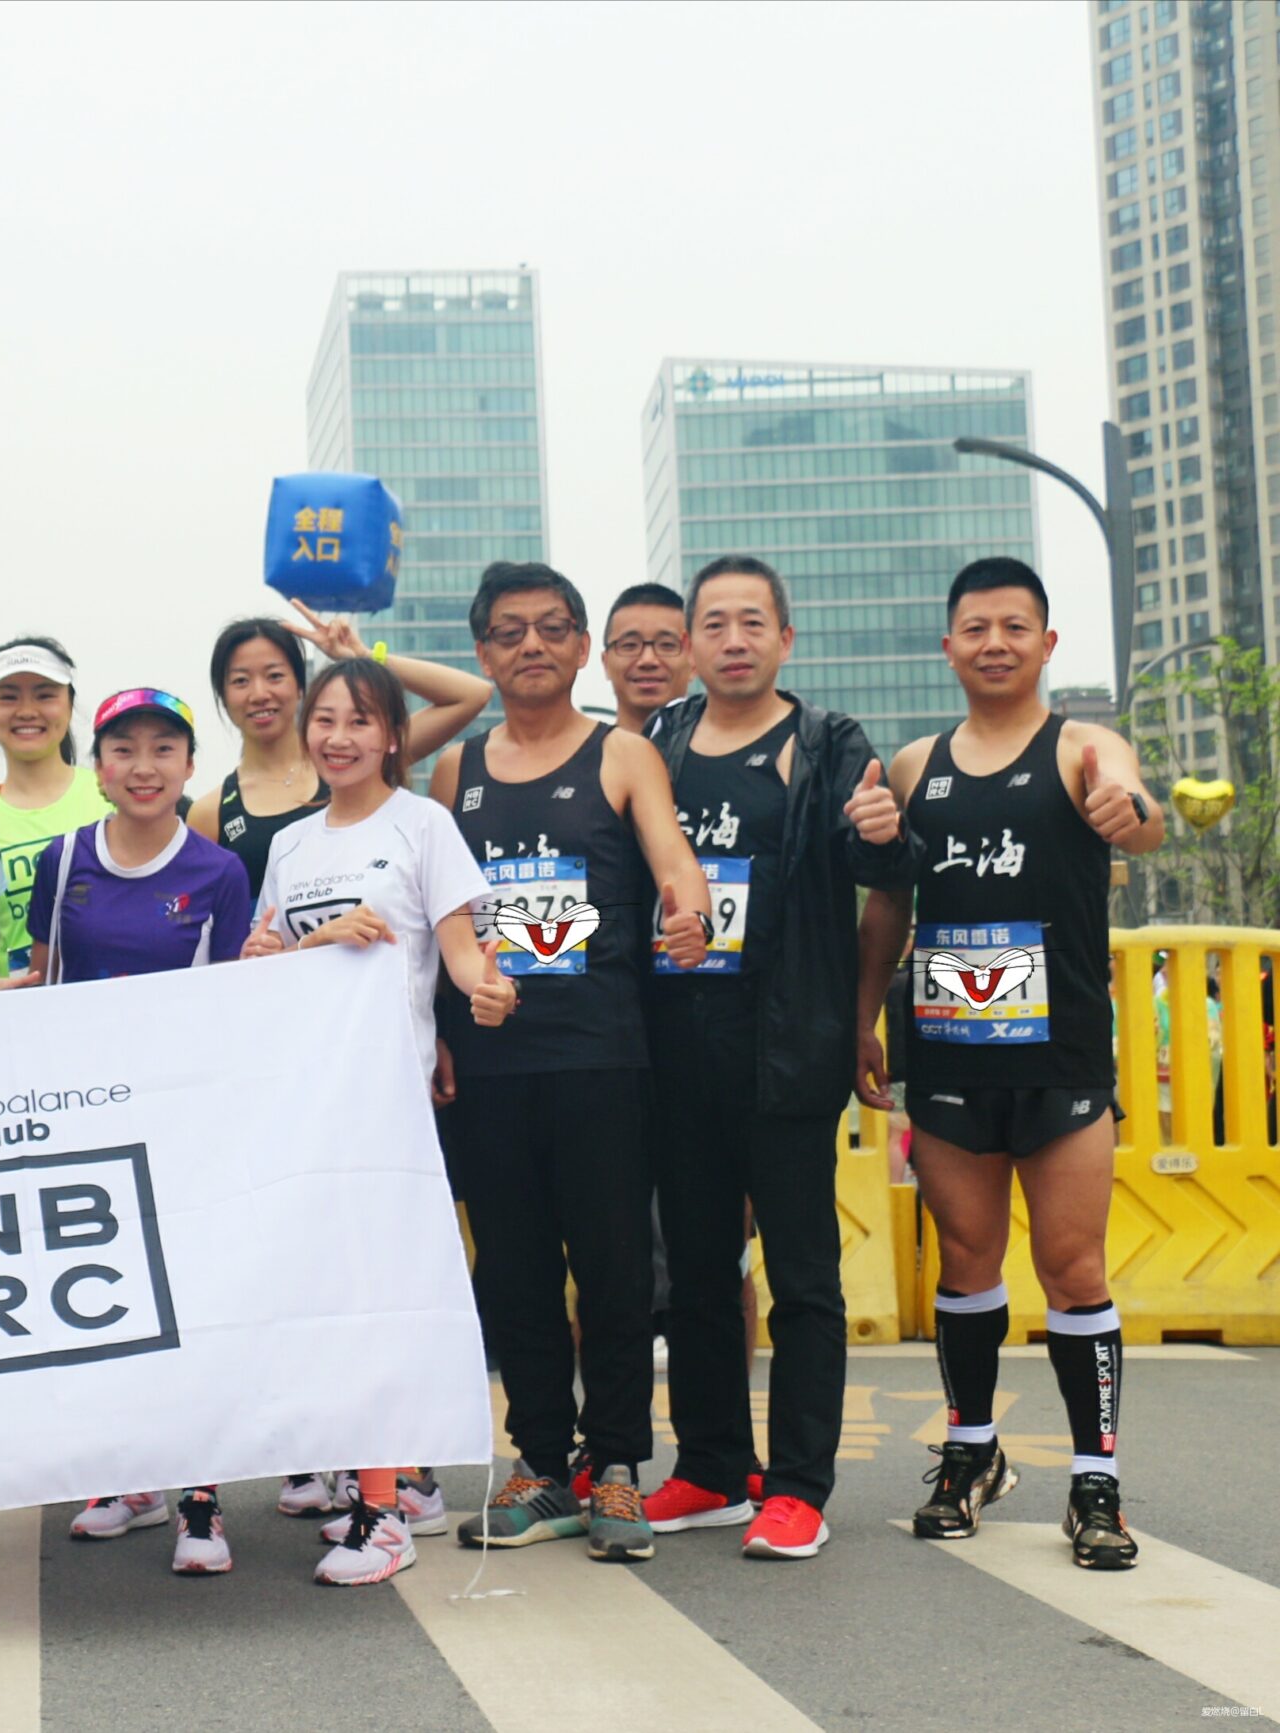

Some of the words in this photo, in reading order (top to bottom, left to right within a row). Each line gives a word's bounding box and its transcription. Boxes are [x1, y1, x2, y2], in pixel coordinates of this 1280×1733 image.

[291, 536, 341, 562] 入口
[933, 828, 1026, 877] 上海
[314, 872, 365, 887] balance
[306, 887, 334, 900] club
[936, 928, 1010, 946] 东风雷诺
